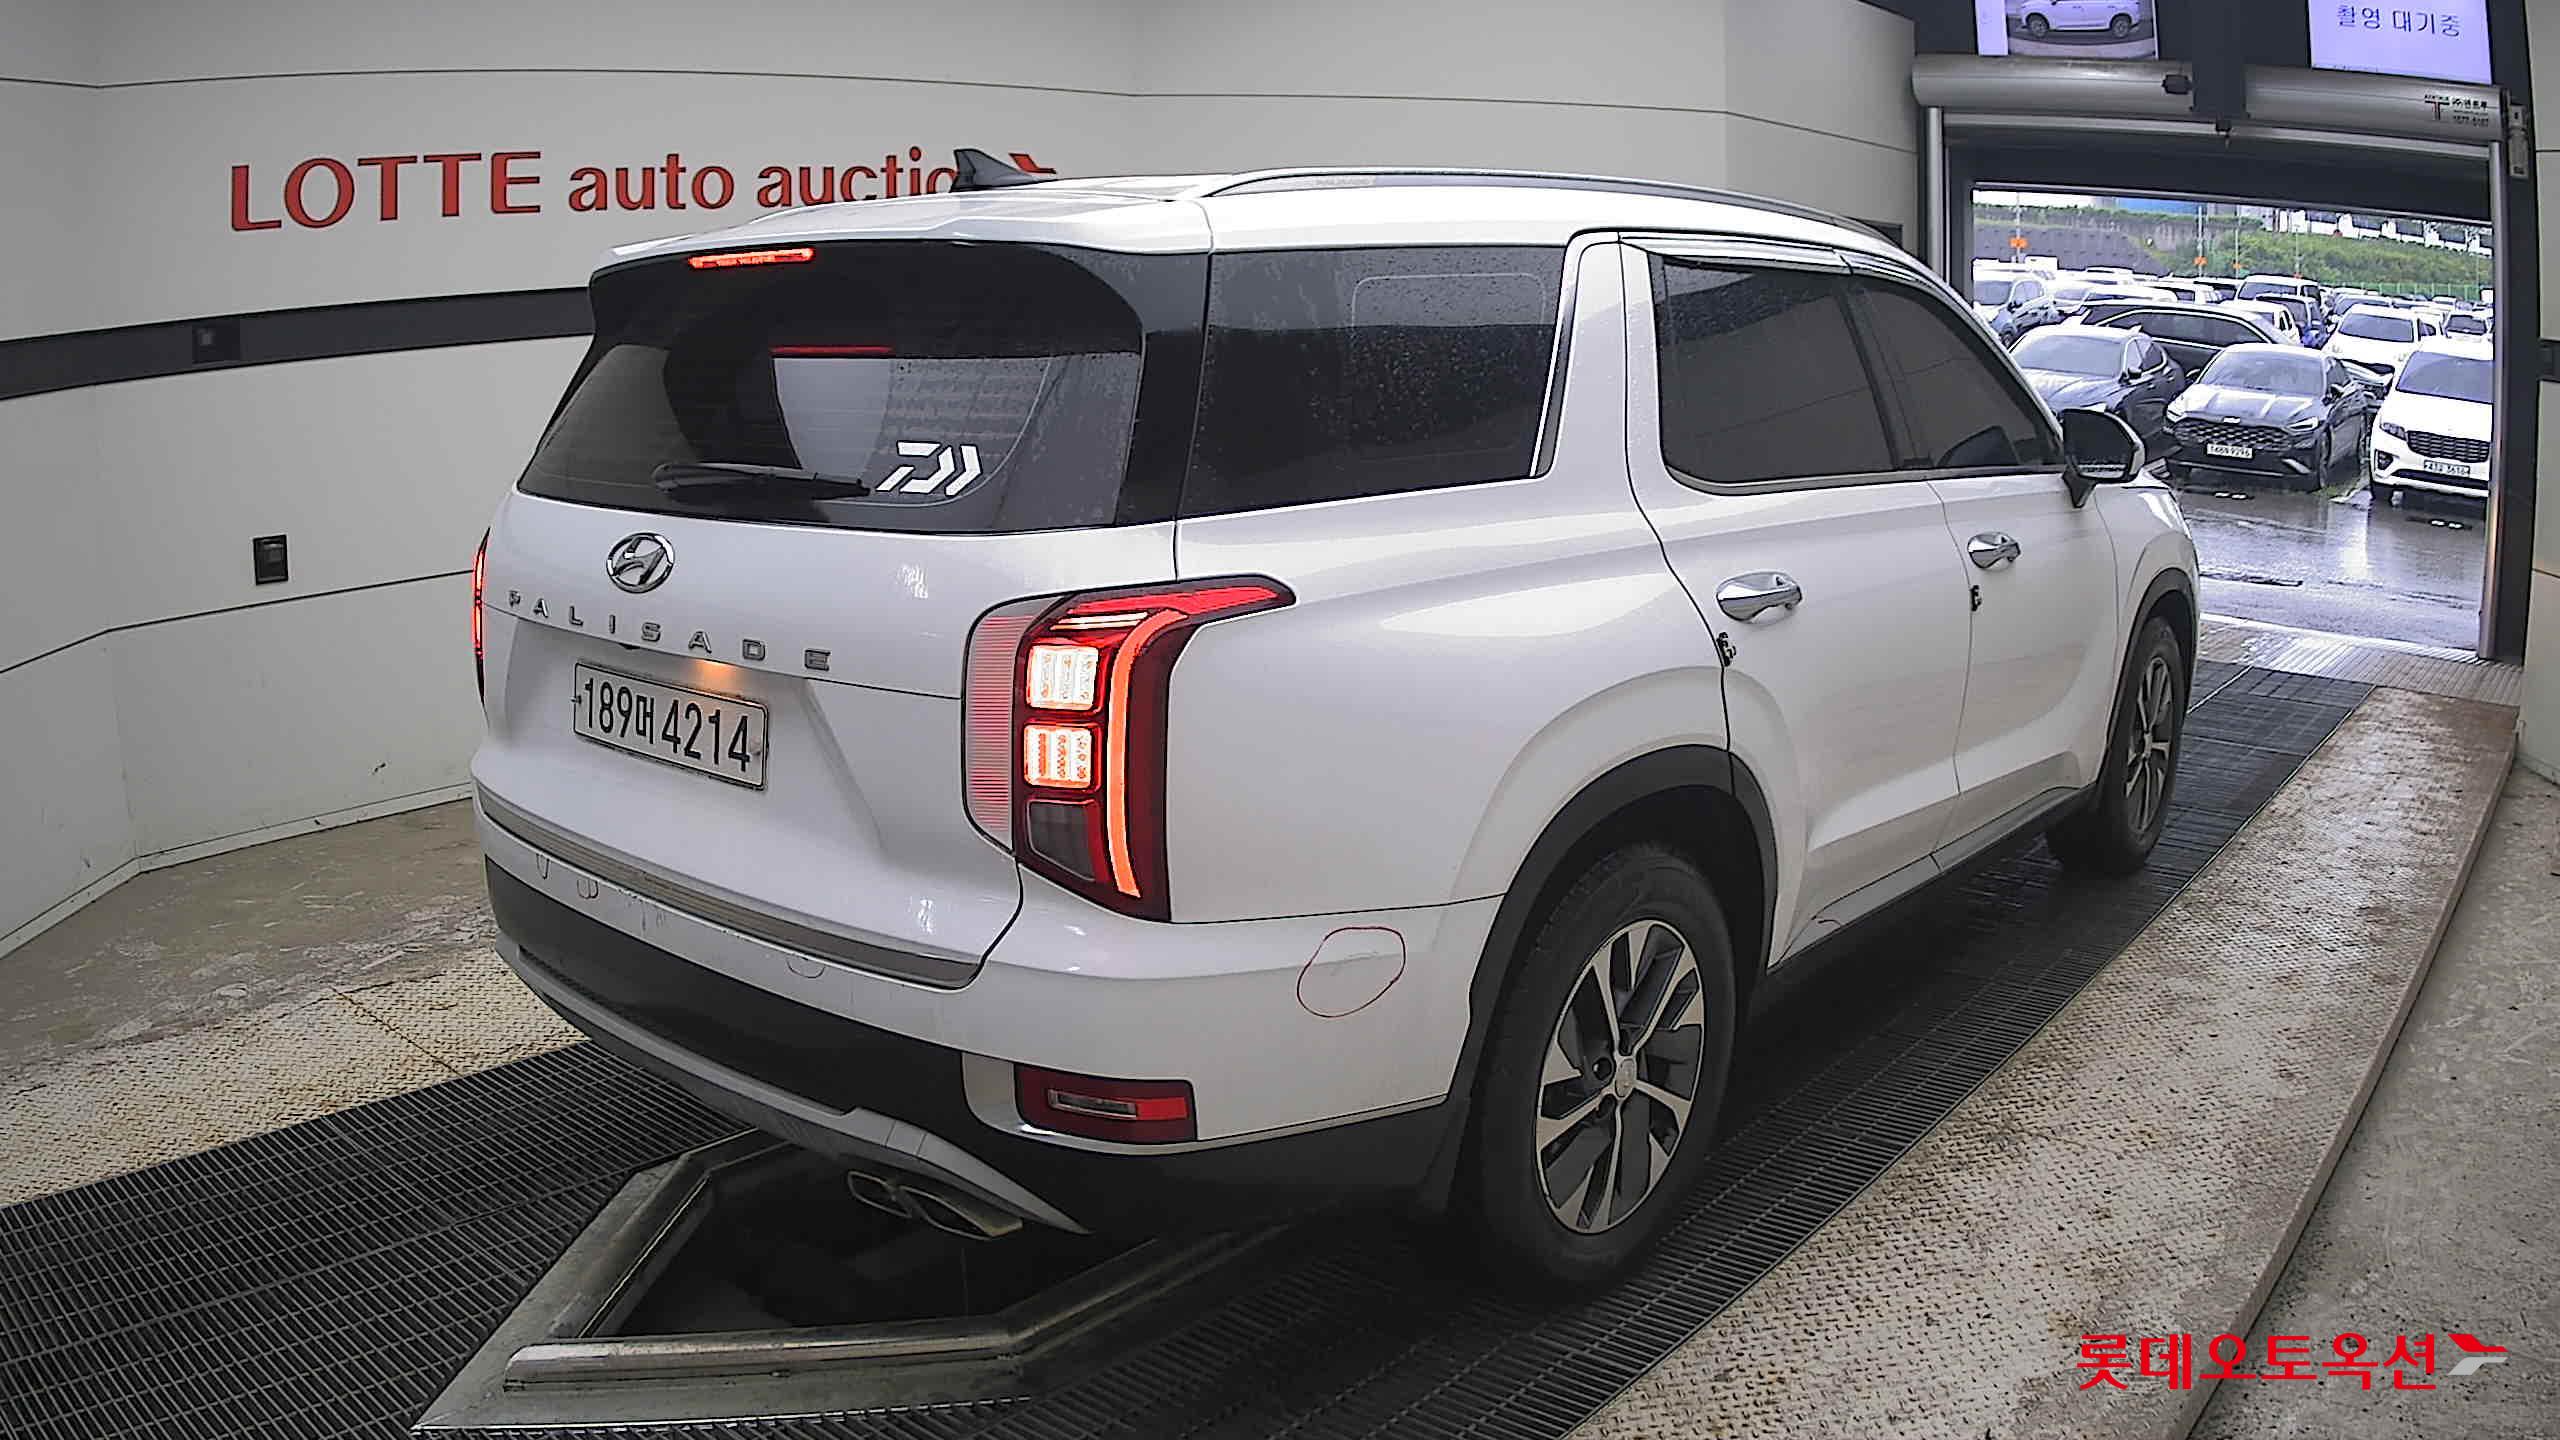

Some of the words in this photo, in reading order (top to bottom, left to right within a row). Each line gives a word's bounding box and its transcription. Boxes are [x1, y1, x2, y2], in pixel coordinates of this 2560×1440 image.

[2337, 4, 2381, 30] 촬영
[2392, 10, 2461, 38] 대기중
[229, 150, 542, 232] LOTTE
[567, 152, 735, 212] auto
[756, 145, 960, 207] auctio
[507, 588, 832, 672] PALISADE
[584, 676, 655, 745] 189머
[661, 699, 751, 773] 4214
